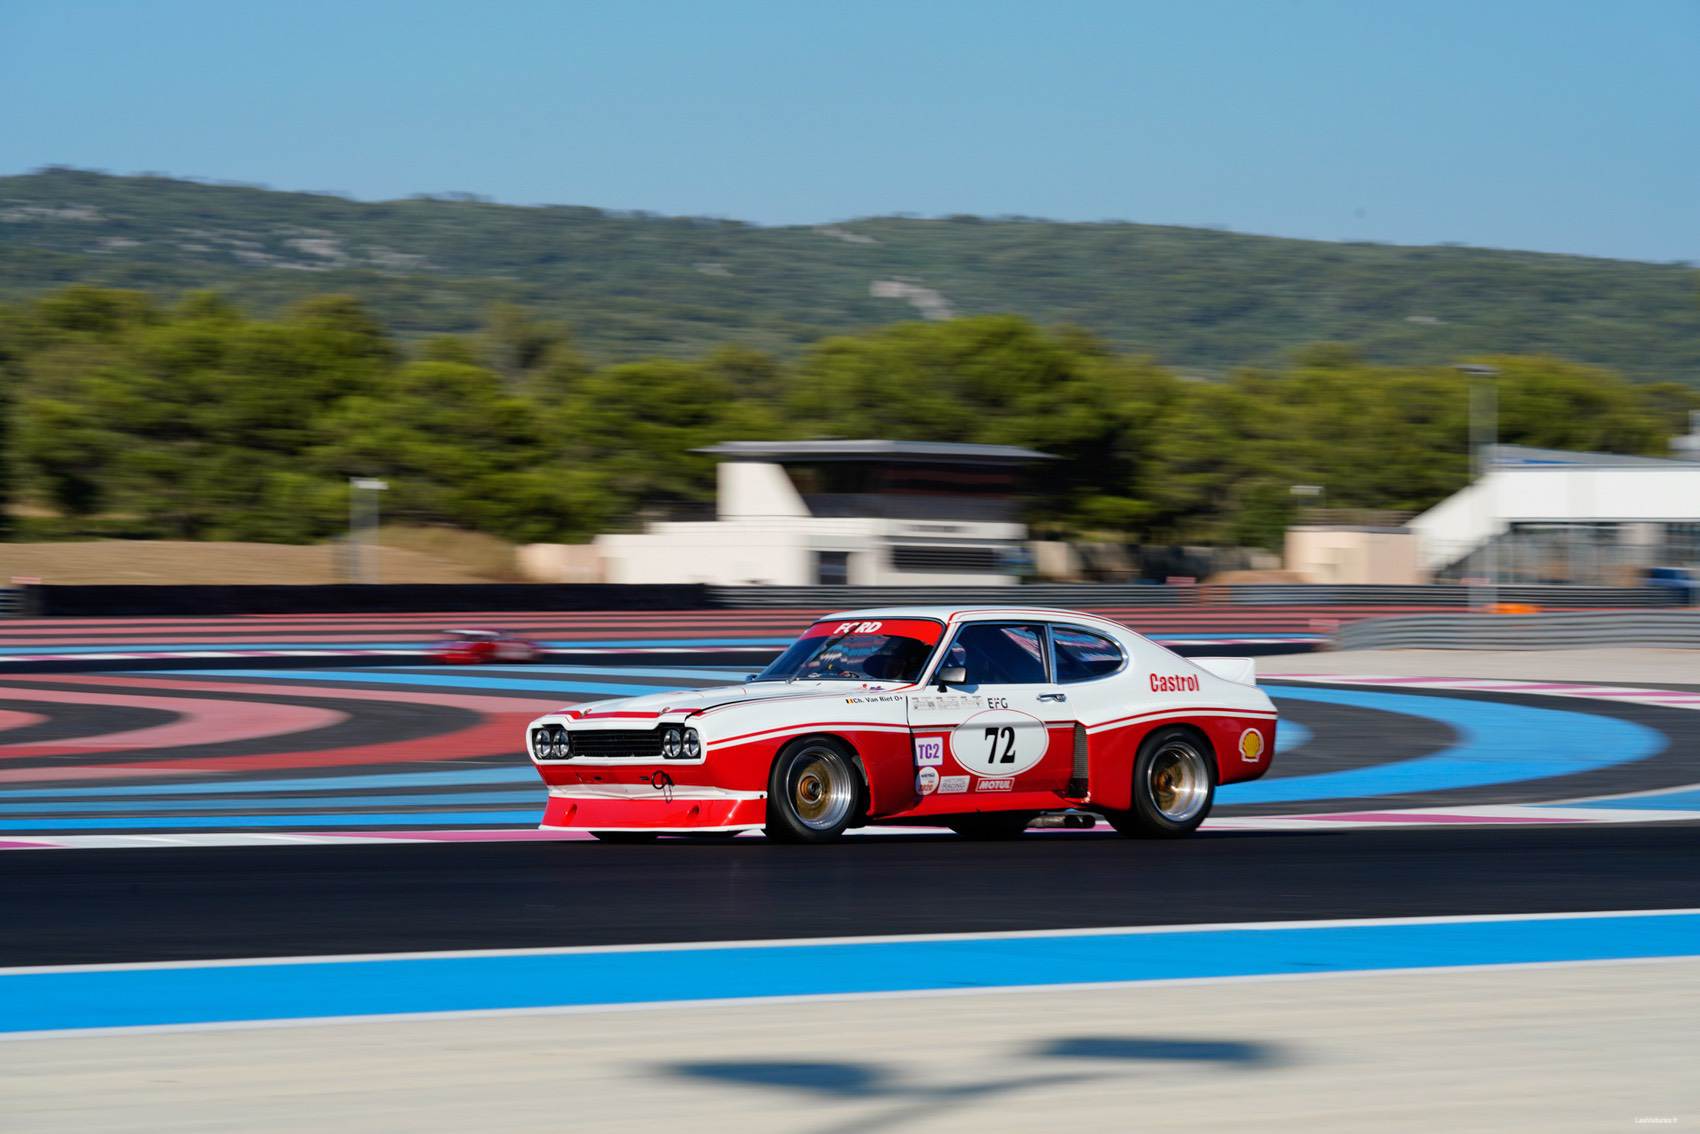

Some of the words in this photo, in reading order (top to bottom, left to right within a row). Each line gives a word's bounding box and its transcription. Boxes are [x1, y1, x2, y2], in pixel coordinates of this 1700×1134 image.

[1149, 673, 1200, 692] Castrol
[918, 743, 940, 760] TC2
[984, 726, 1016, 764] 72
[978, 780, 1011, 790] MOTUL
